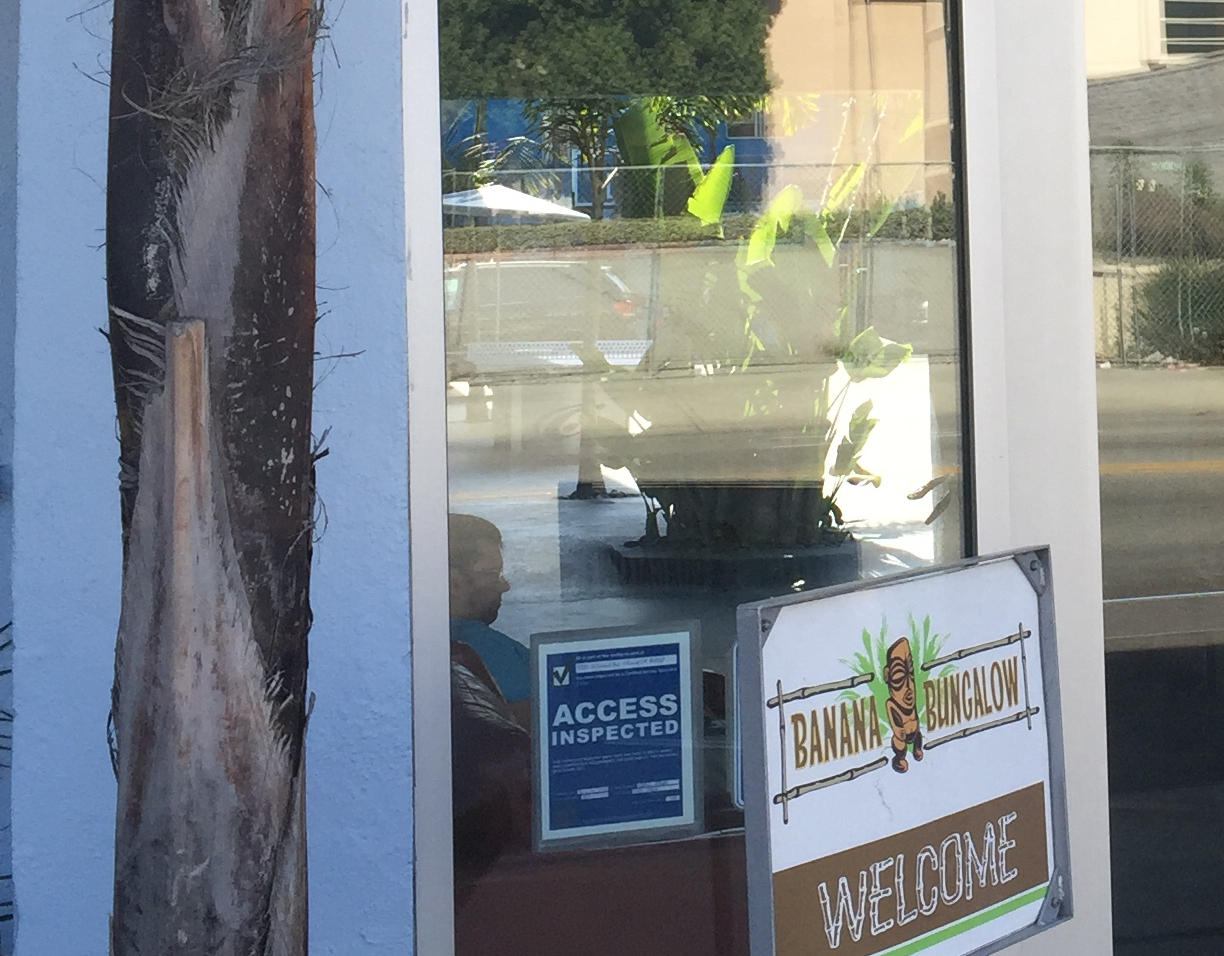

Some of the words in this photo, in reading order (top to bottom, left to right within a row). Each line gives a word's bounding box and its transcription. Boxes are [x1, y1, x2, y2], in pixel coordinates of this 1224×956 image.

[551, 719, 680, 746] INSPECTED
[552, 693, 679, 726] ACCESS
[790, 695, 883, 770] BANANA
[923, 655, 1020, 733] BUNGALOW
[817, 811, 1019, 949] WELCOME
